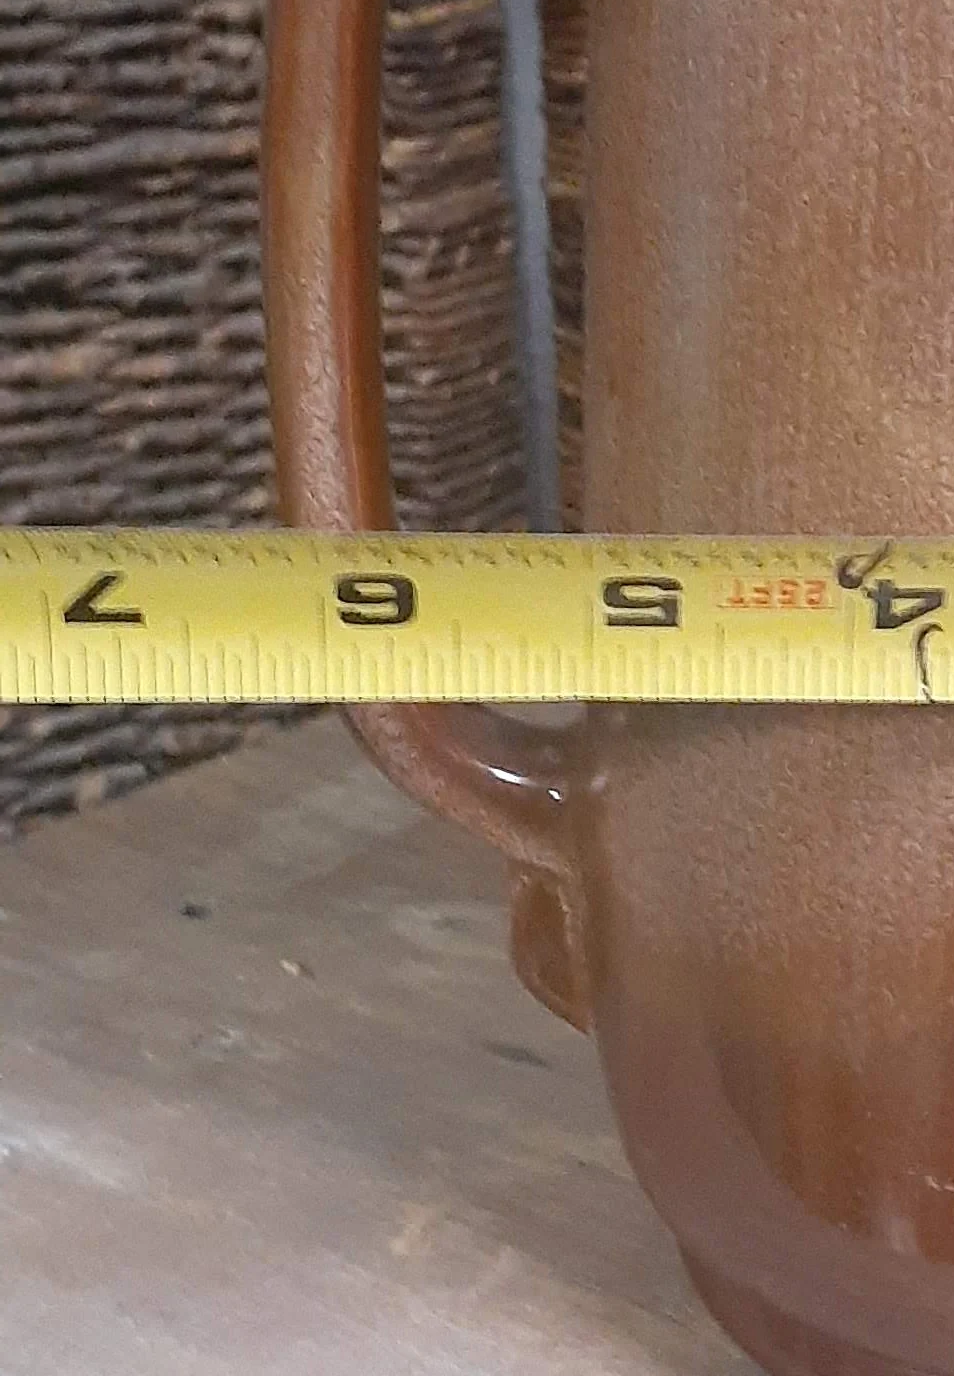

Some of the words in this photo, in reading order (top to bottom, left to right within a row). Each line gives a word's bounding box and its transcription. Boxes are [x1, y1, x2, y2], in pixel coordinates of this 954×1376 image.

[62, 572, 145, 623] 7
[336, 572, 417, 625] 6
[601, 575, 683, 628] 5
[869, 577, 946, 630] 4
